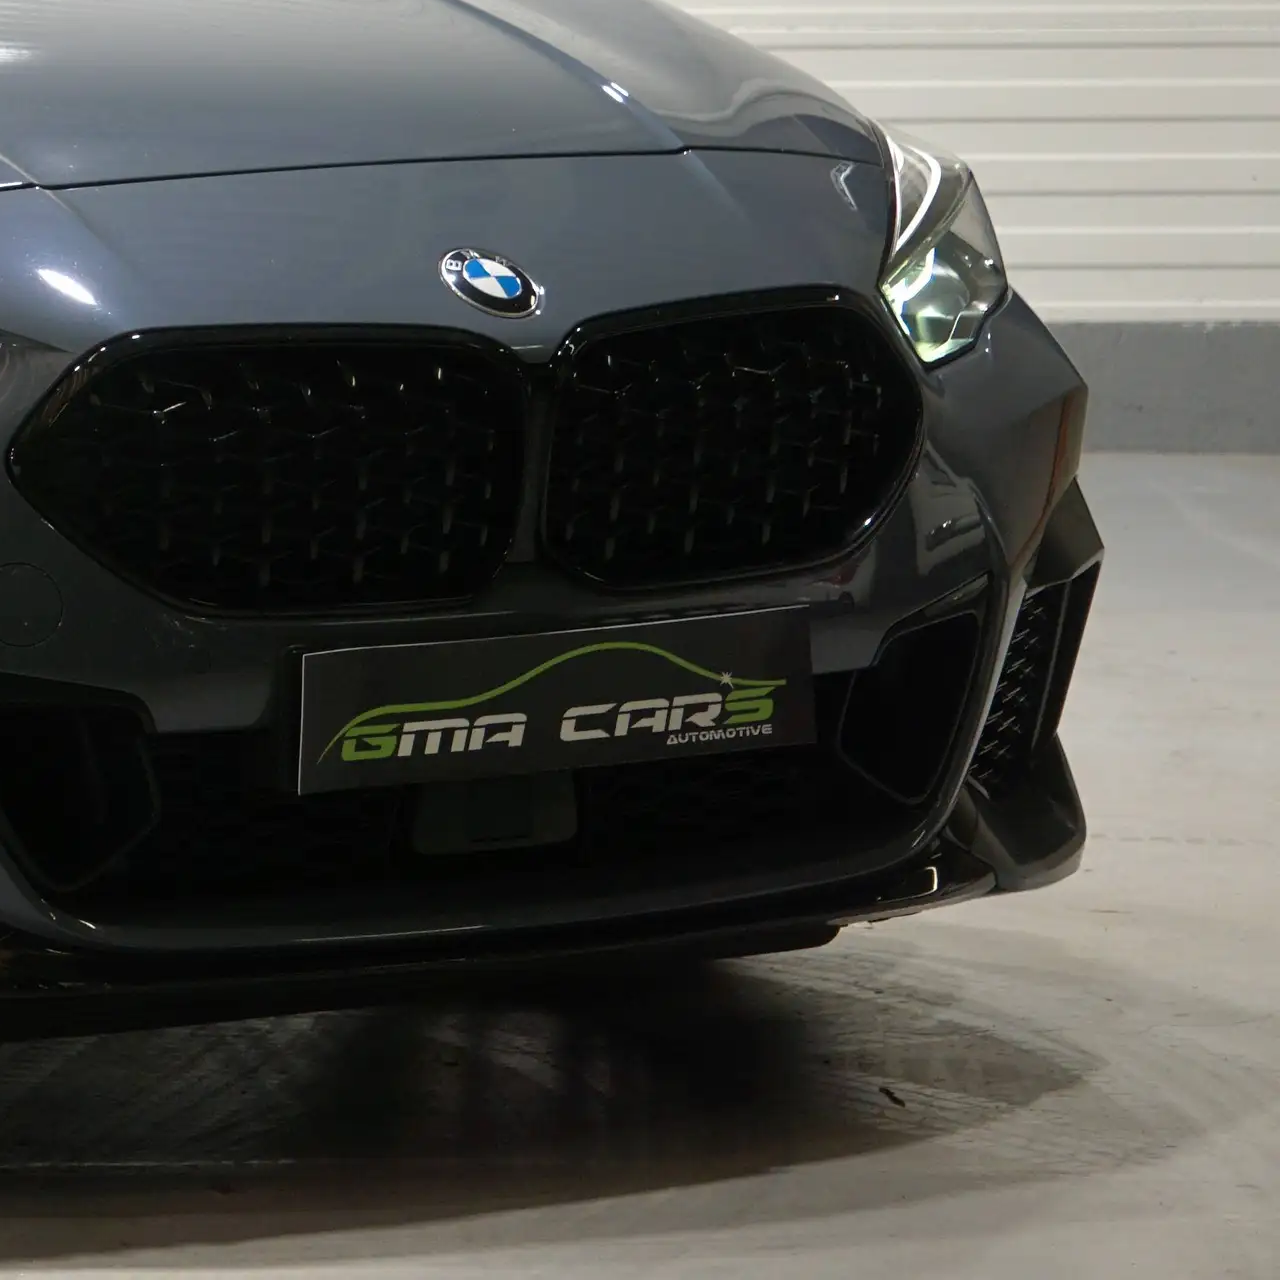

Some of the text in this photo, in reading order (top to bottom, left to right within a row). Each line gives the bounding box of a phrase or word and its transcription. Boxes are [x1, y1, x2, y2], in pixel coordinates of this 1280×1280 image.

[341, 686, 777, 762] GMA CARS
[667, 724, 773, 746] AUTOMOTIVE
